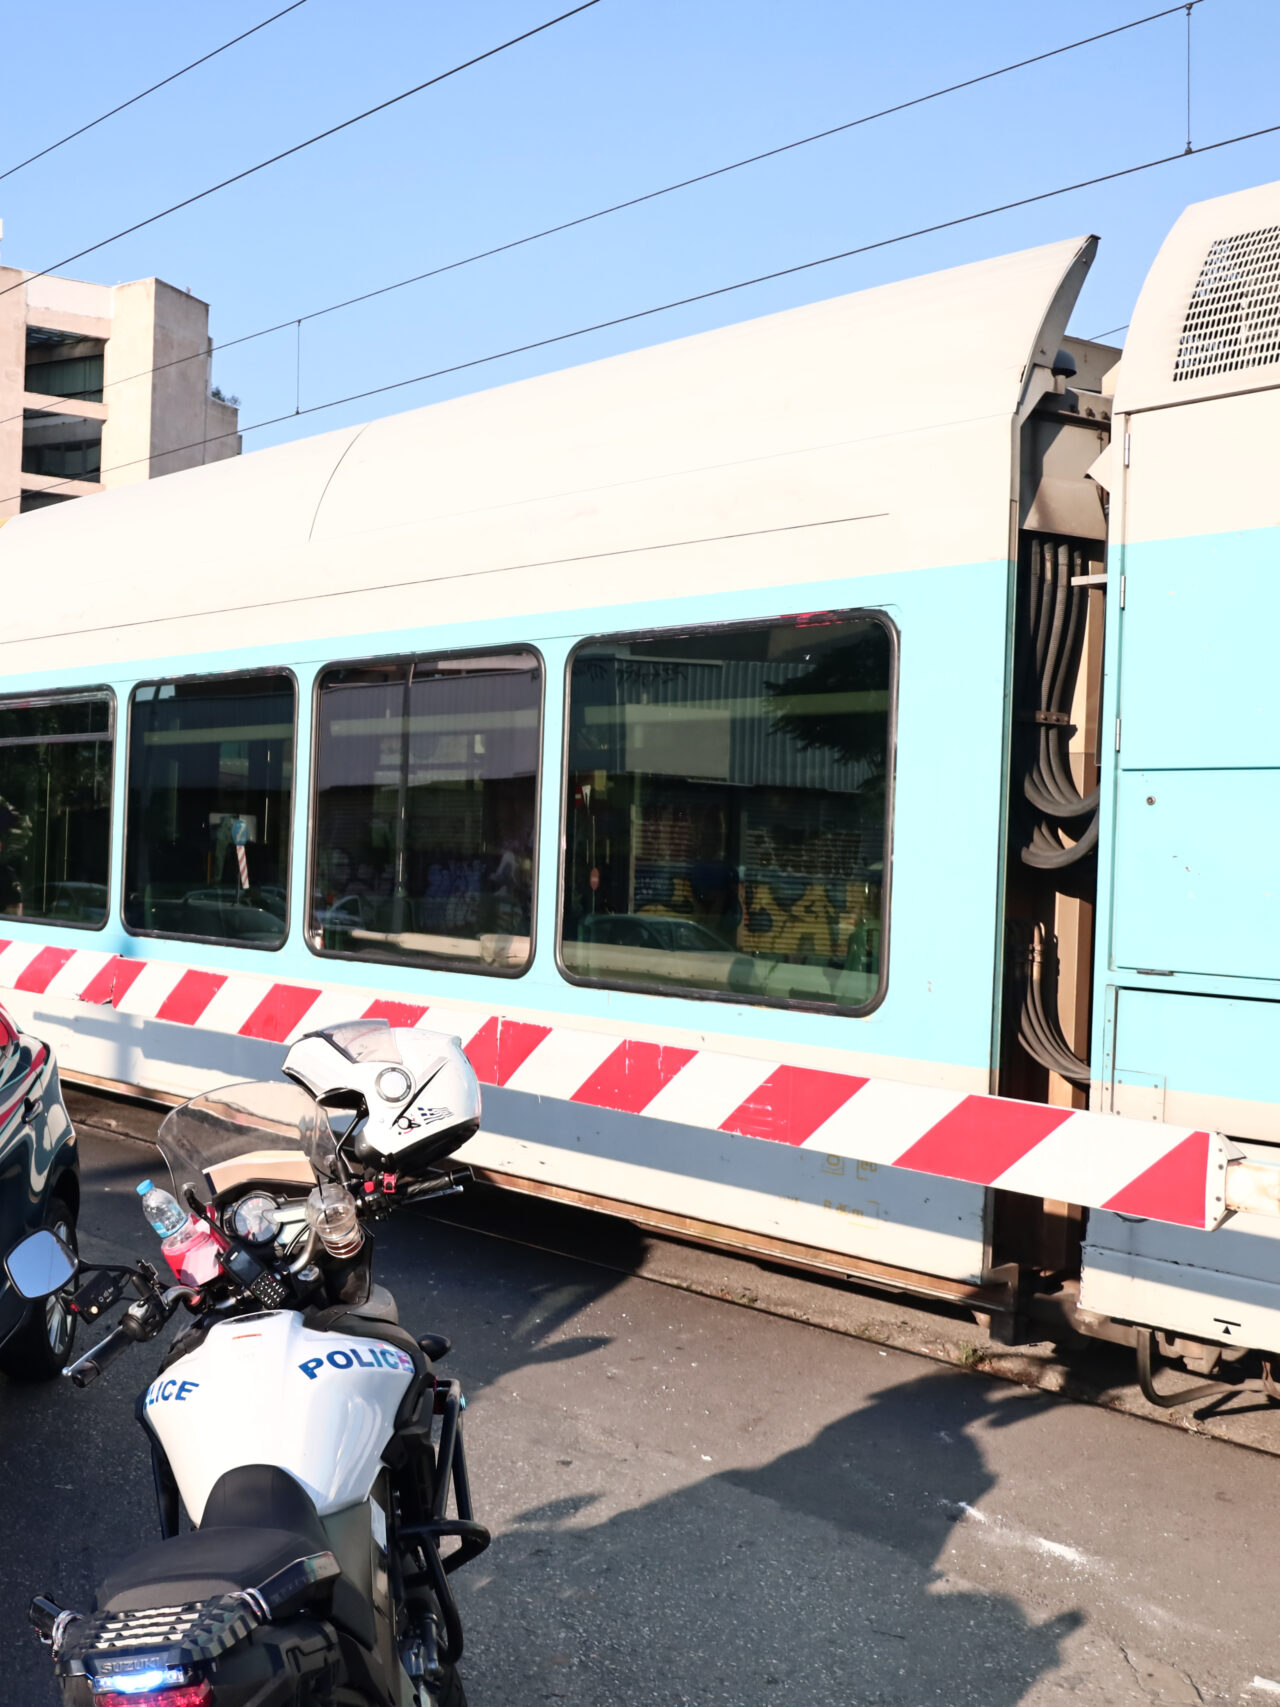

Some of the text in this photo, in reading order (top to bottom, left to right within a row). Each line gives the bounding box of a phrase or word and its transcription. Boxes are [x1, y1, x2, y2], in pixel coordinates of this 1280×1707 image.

[298, 1348, 416, 1380] POLICE
[144, 1379, 200, 1409] LICE
[100, 1656, 161, 1674] SUZUKI
